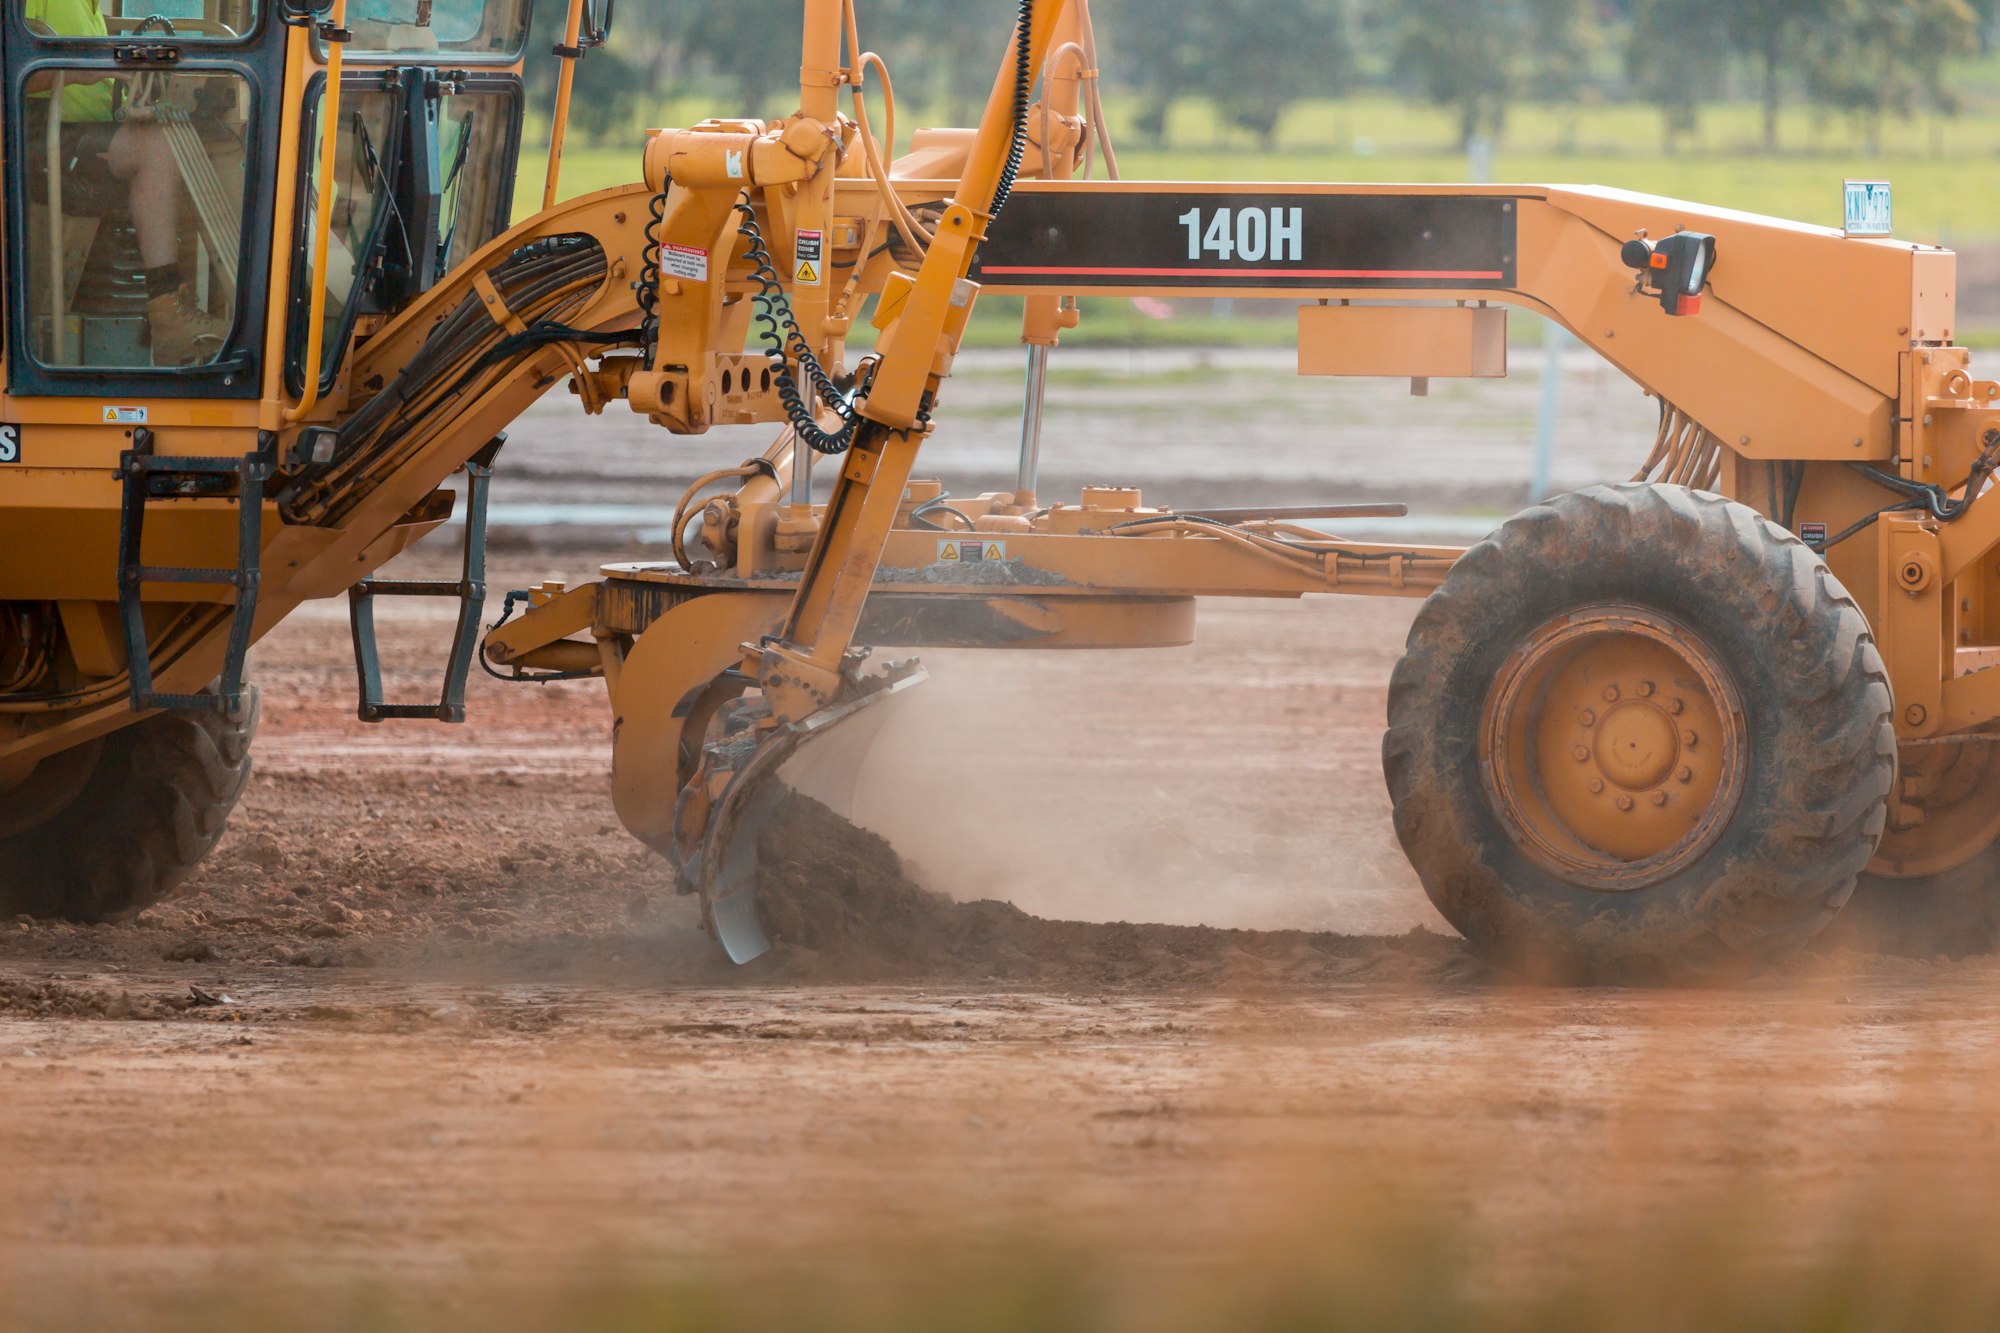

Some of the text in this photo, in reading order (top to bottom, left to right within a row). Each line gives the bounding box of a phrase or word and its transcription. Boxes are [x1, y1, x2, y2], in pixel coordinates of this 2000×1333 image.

[1847, 191, 1890, 220] XNU 979
[1178, 207, 1302, 262] 140H
[672, 245, 705, 255] WARNING
